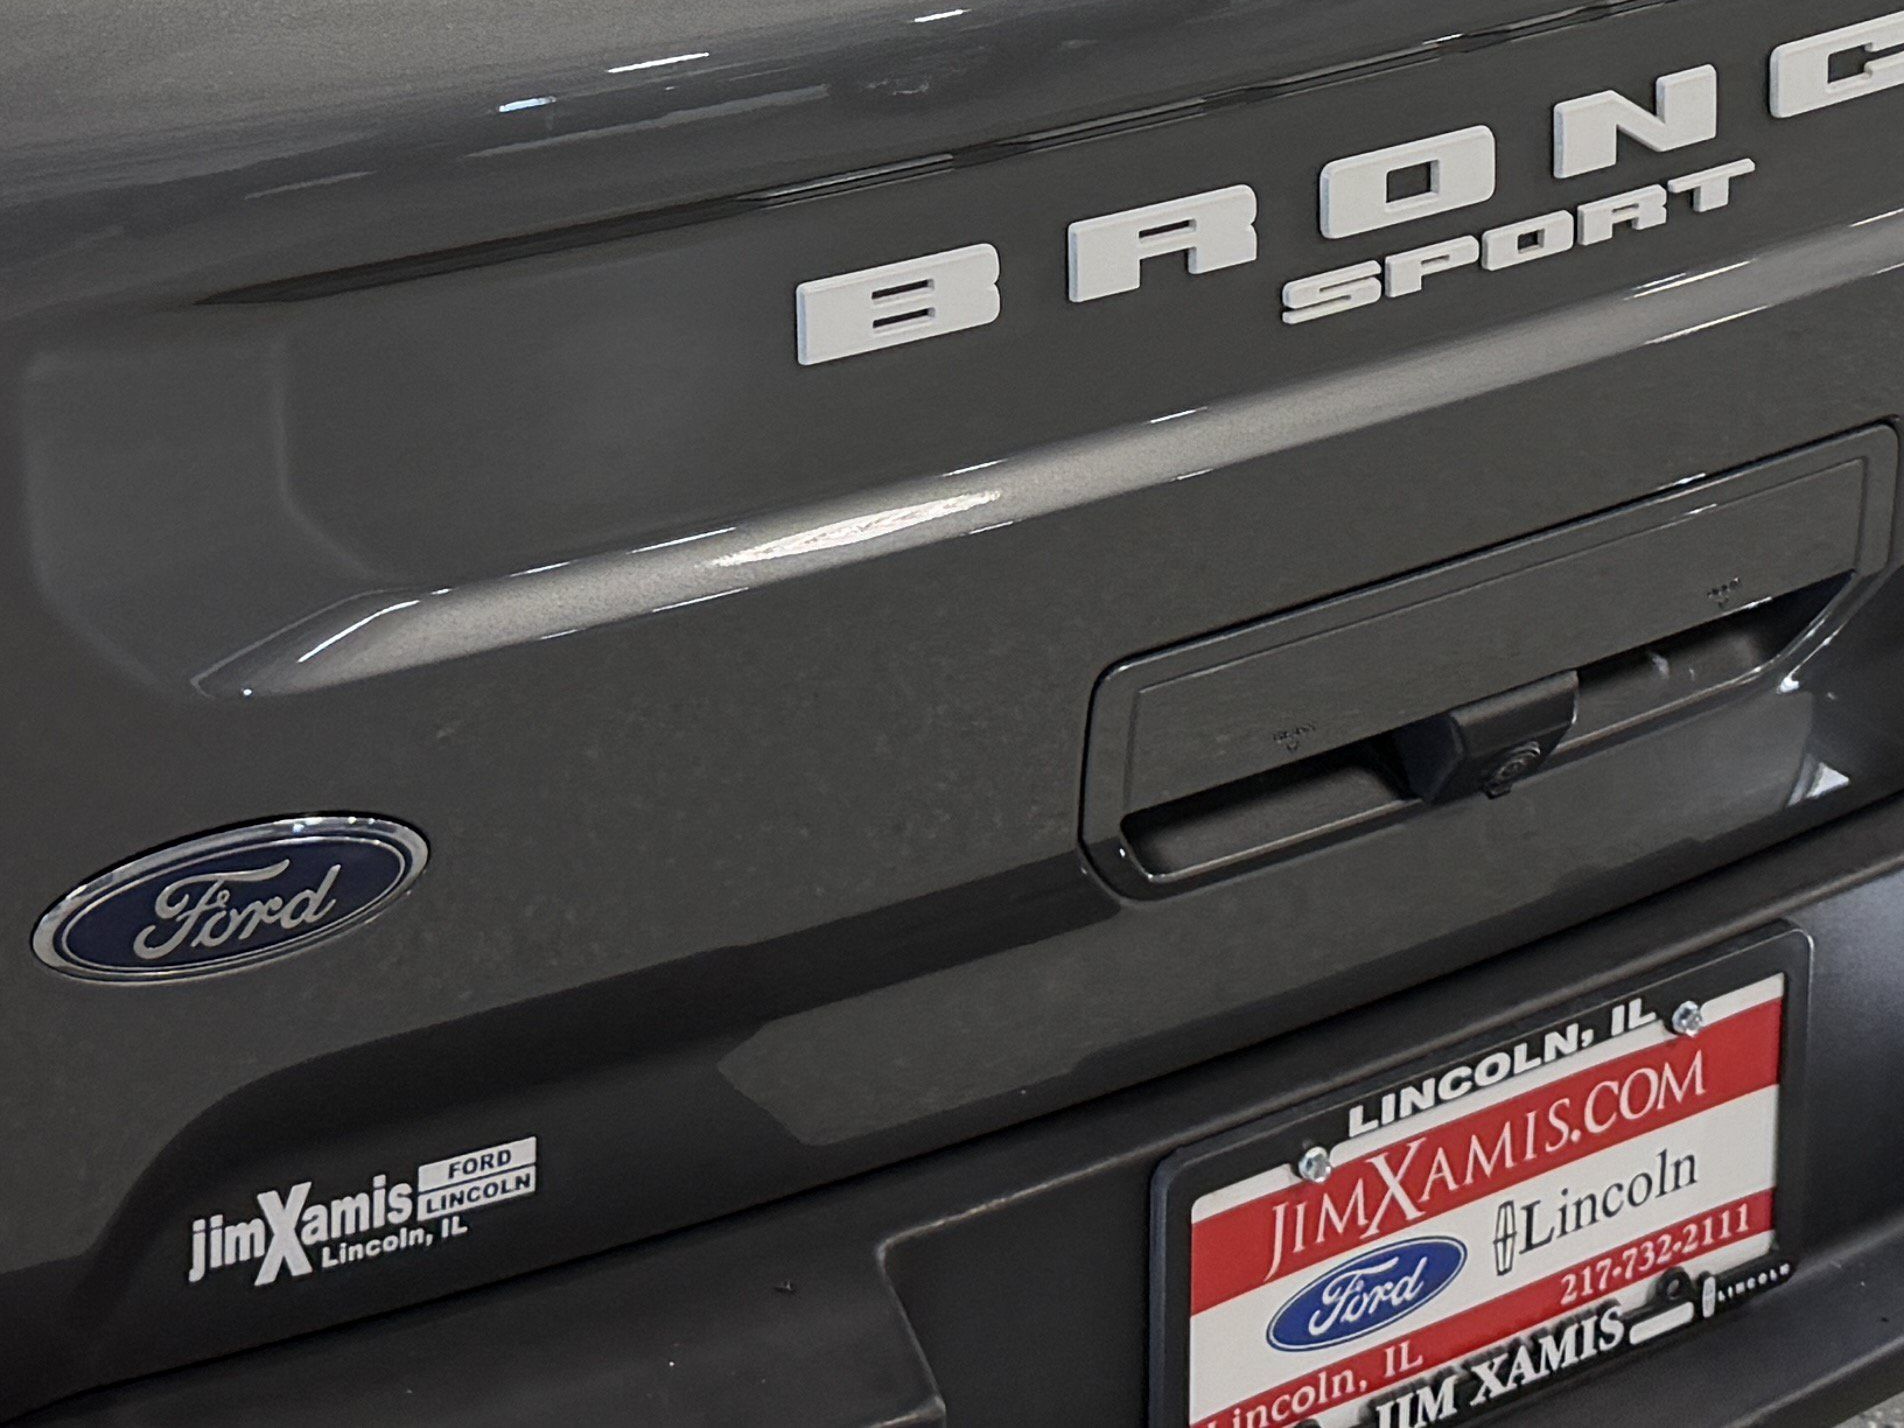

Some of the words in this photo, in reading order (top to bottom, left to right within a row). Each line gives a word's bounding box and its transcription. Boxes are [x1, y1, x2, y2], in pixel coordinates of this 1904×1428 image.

[1281, 157, 1756, 325] SPORT
[133, 859, 343, 961] Ford
[1348, 1023, 1595, 1139] LINCOLN,
[1611, 997, 1658, 1037] IL
[426, 1173, 532, 1215] LINCOLN
[448, 1149, 513, 1181] FORD
[1519, 1148, 1698, 1255] Lincoln
[322, 1224, 434, 1269] Lincoln,
[441, 1214, 469, 1239] IL
[1307, 1255, 1429, 1337] Ford
[1206, 1369, 1368, 1428] incoln,
[1384, 1340, 1425, 1379] IL
[1469, 1305, 1626, 1408] XAMIS
